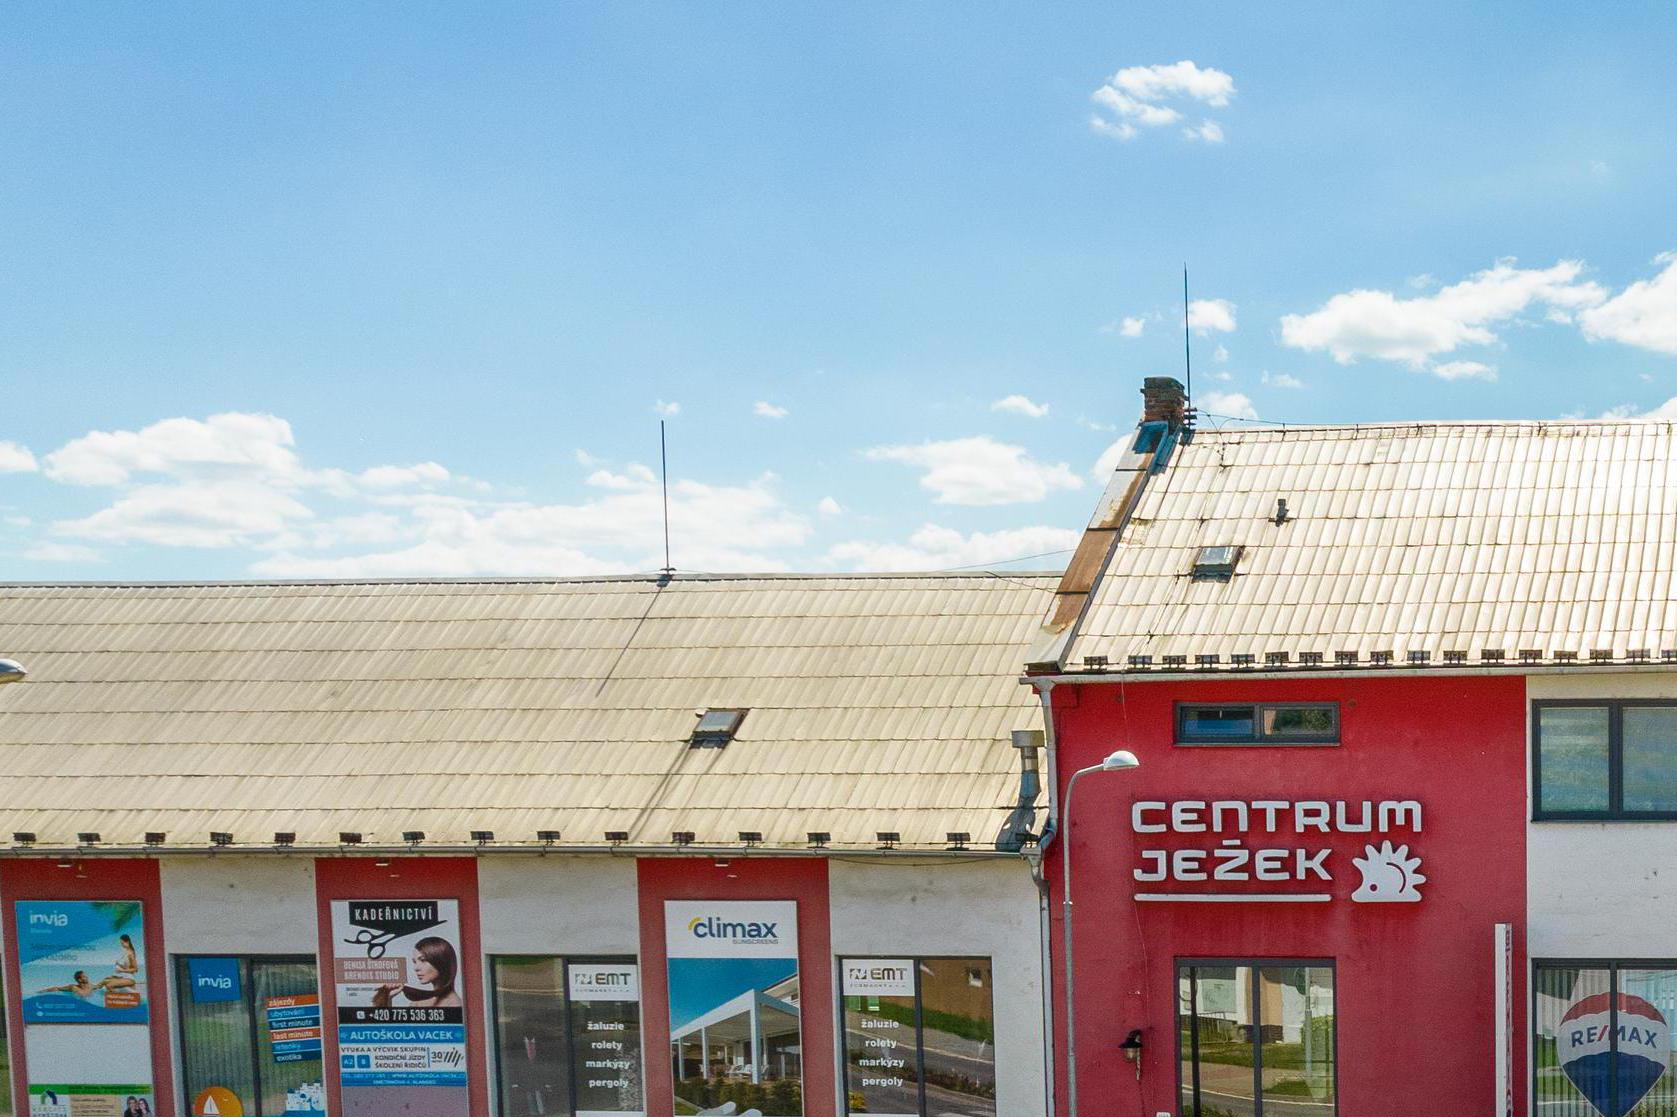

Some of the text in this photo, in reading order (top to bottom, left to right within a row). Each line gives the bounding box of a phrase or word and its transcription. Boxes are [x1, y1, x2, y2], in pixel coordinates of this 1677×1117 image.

[1132, 800, 1422, 833] CENTRUM
[1133, 839, 1333, 881] JEŽEK
[355, 906, 432, 920] KADEŘNICTVÍ
[29, 910, 68, 927] invia
[694, 917, 778, 938] climax
[198, 975, 232, 989] invia
[369, 1010, 390, 1020] +420
[392, 1009, 407, 1020] 775
[428, 1009, 445, 1020] 363
[587, 1021, 625, 1031] žaluzie
[861, 1019, 900, 1028] žaluzie
[350, 1029, 453, 1040] AUTOŠKOLA VACEK
[592, 1041, 622, 1050] rolety
[865, 1039, 897, 1048] rolety
[586, 1060, 630, 1069] markýzy
[859, 1058, 904, 1067] markýzy
[589, 1079, 629, 1088] pergoly
[862, 1077, 903, 1087] pergoly
